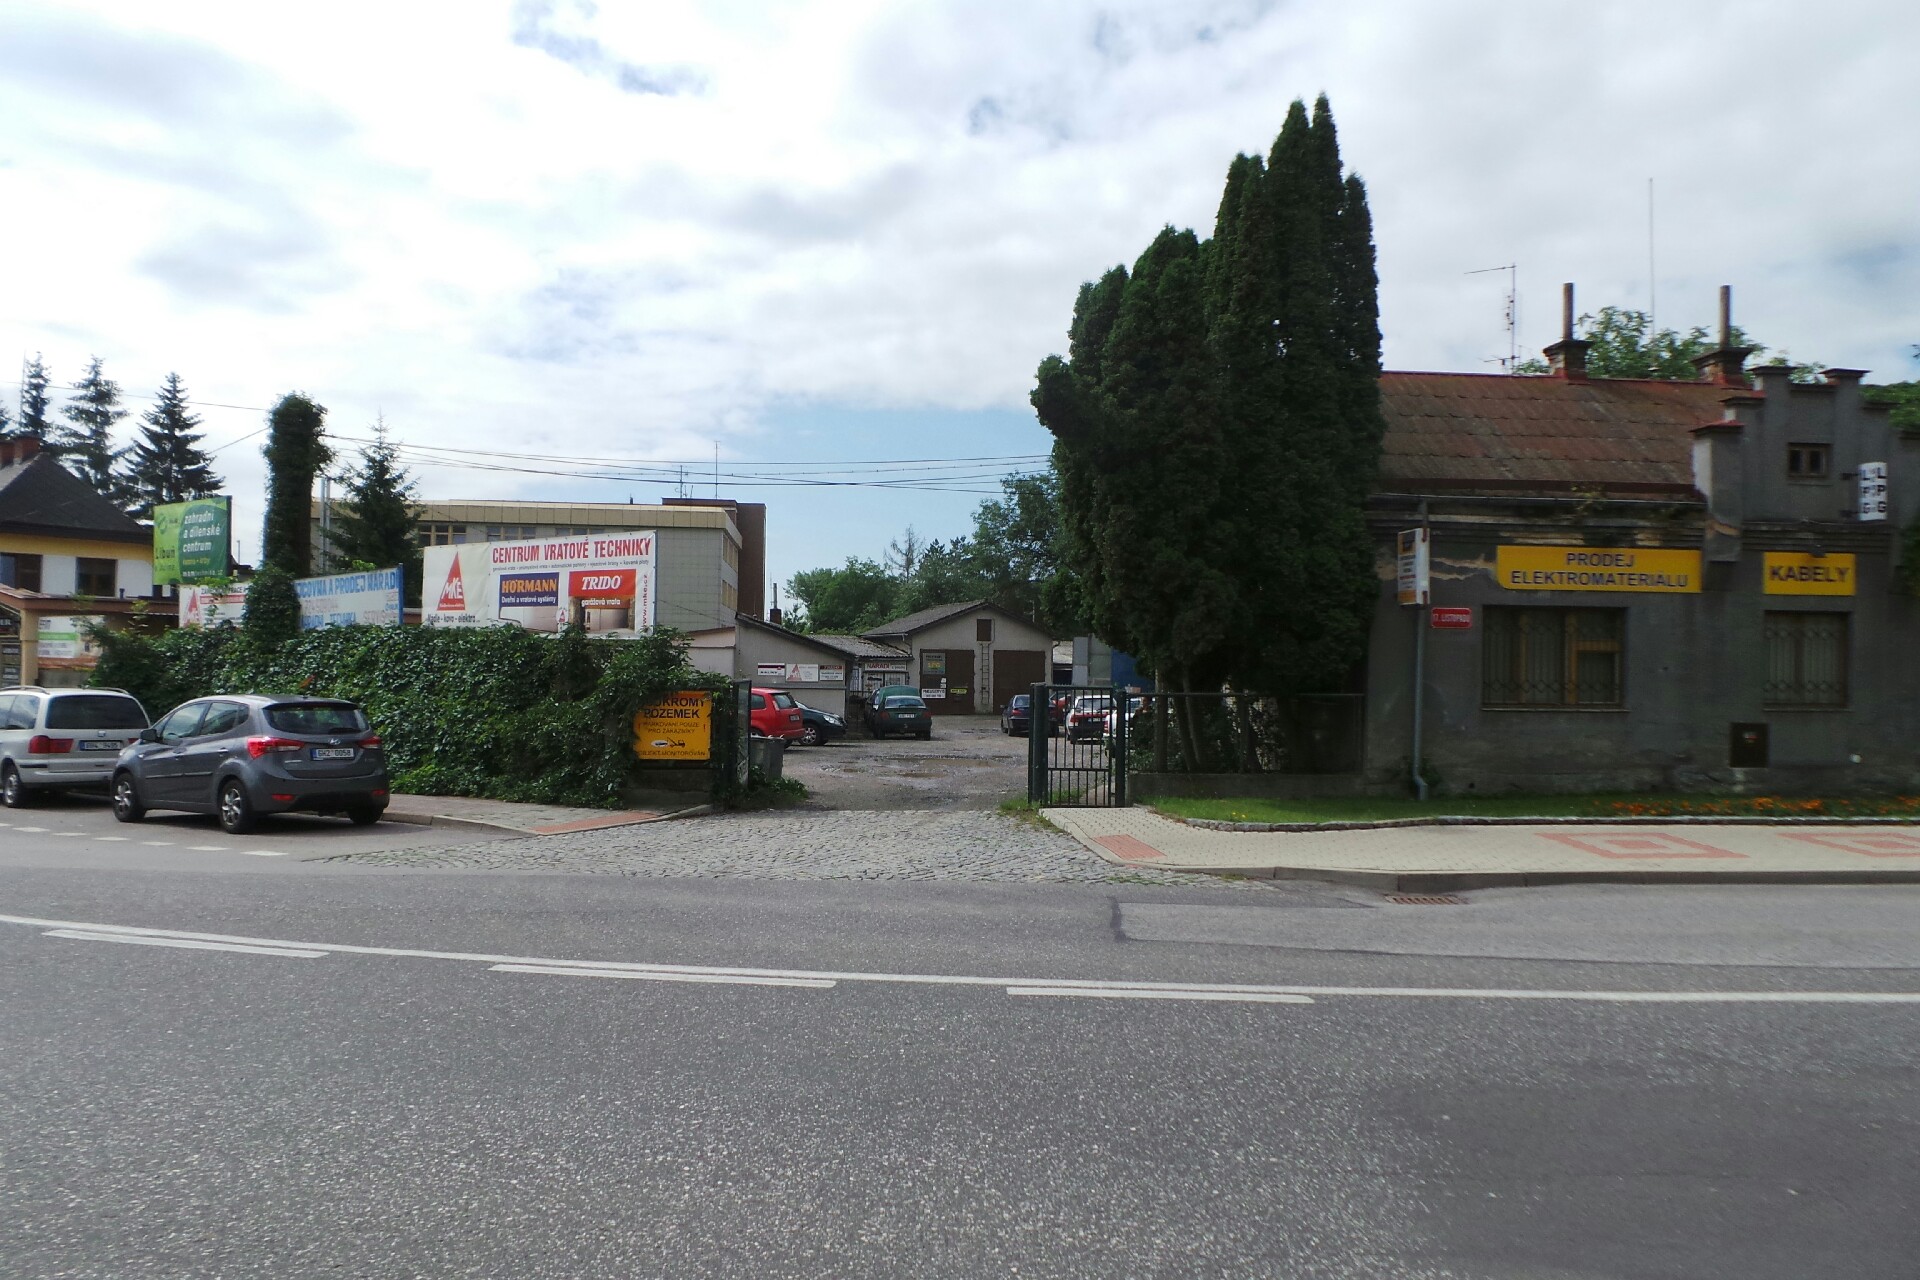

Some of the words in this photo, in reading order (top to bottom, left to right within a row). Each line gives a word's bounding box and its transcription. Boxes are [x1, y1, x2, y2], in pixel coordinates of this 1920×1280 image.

[183, 529, 188, 539] a
[182, 541, 212, 553] centrum
[492, 544, 540, 563] CENTRUM
[544, 537, 589, 560] VRATOVÉ
[594, 537, 651, 558] TECHNIKY
[1566, 553, 1634, 567] PRODEJ
[1511, 570, 1688, 587] ELEKTROMATERIÁLU
[1769, 565, 1850, 583] KABELY
[334, 575, 366, 595] PRODEJ
[582, 575, 621, 590] TRIDO
[643, 708, 700, 718] POZEMEK
